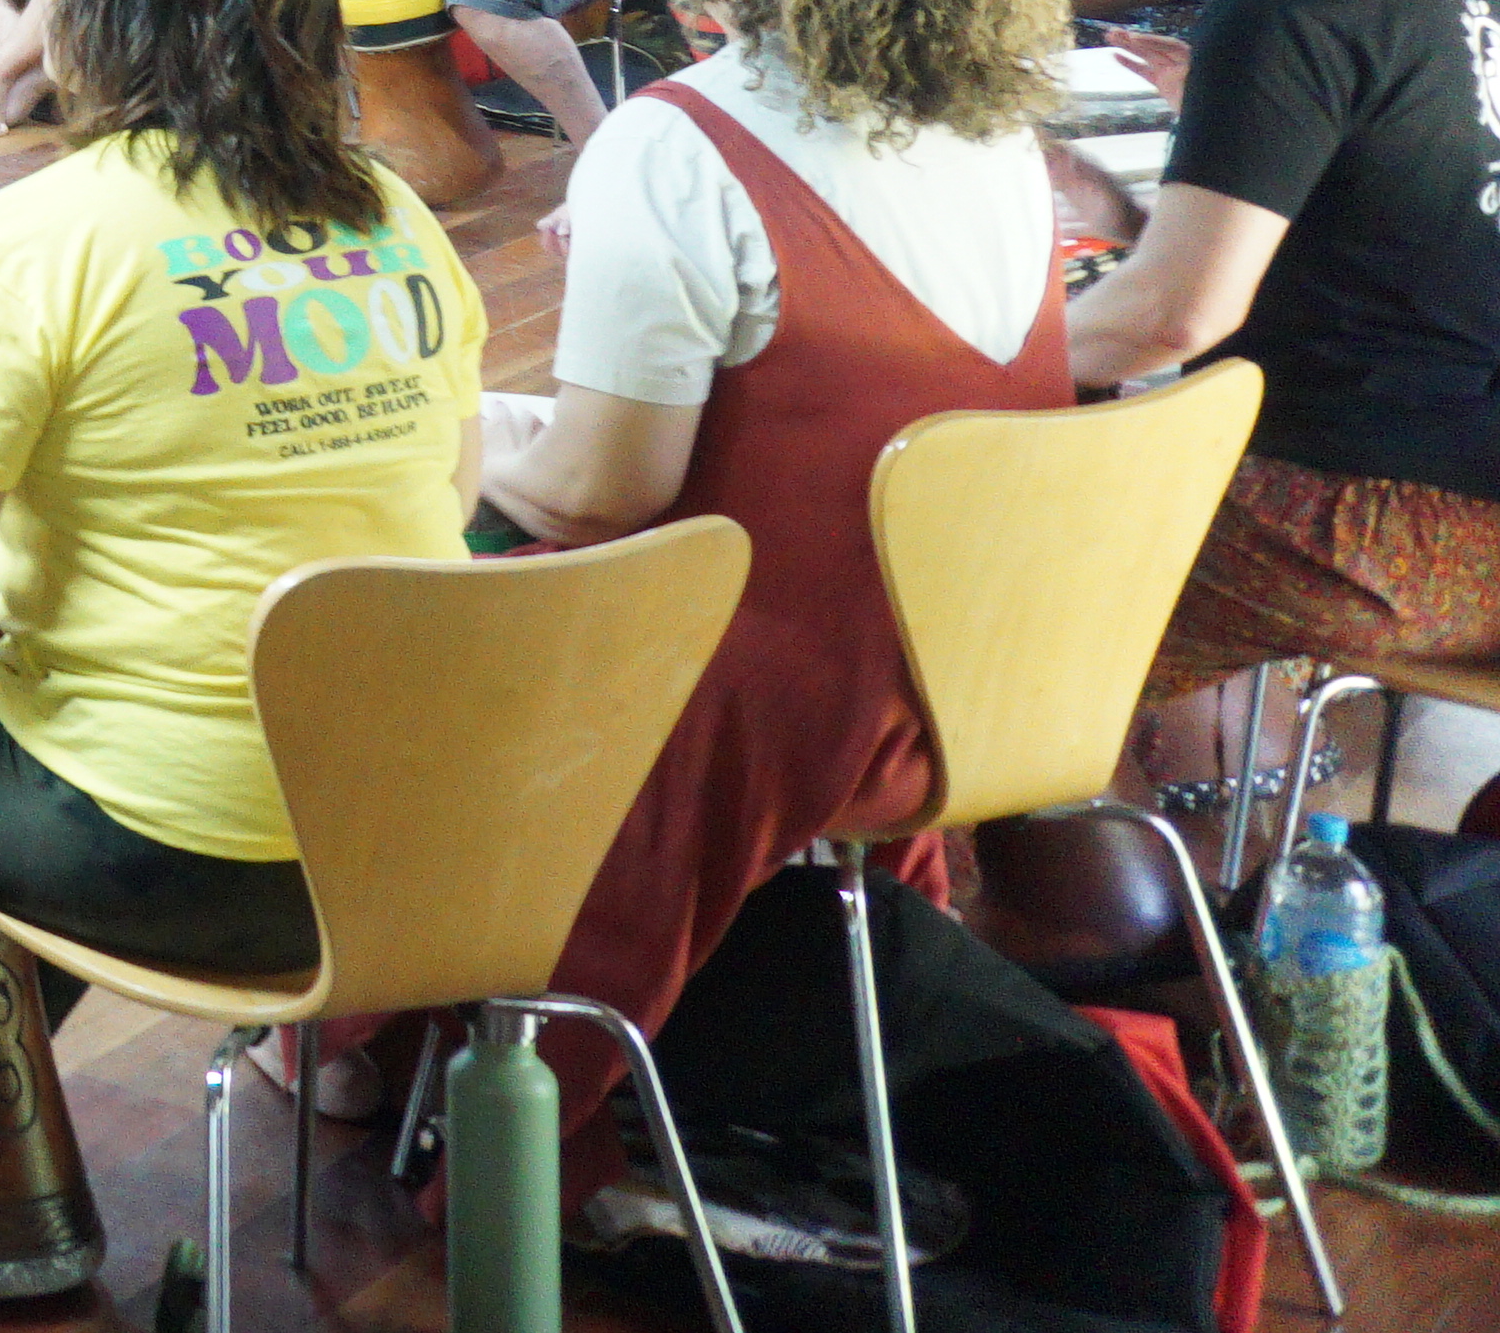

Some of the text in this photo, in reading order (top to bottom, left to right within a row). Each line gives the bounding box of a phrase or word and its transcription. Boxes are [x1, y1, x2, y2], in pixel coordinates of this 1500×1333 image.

[174, 244, 429, 300] YOUR
[179, 274, 444, 395] MOOD
[246, 419, 298, 437] FEEL
[357, 402, 378, 419] BE
[255, 396, 312, 416] WORK
[279, 441, 315, 458] CALL
